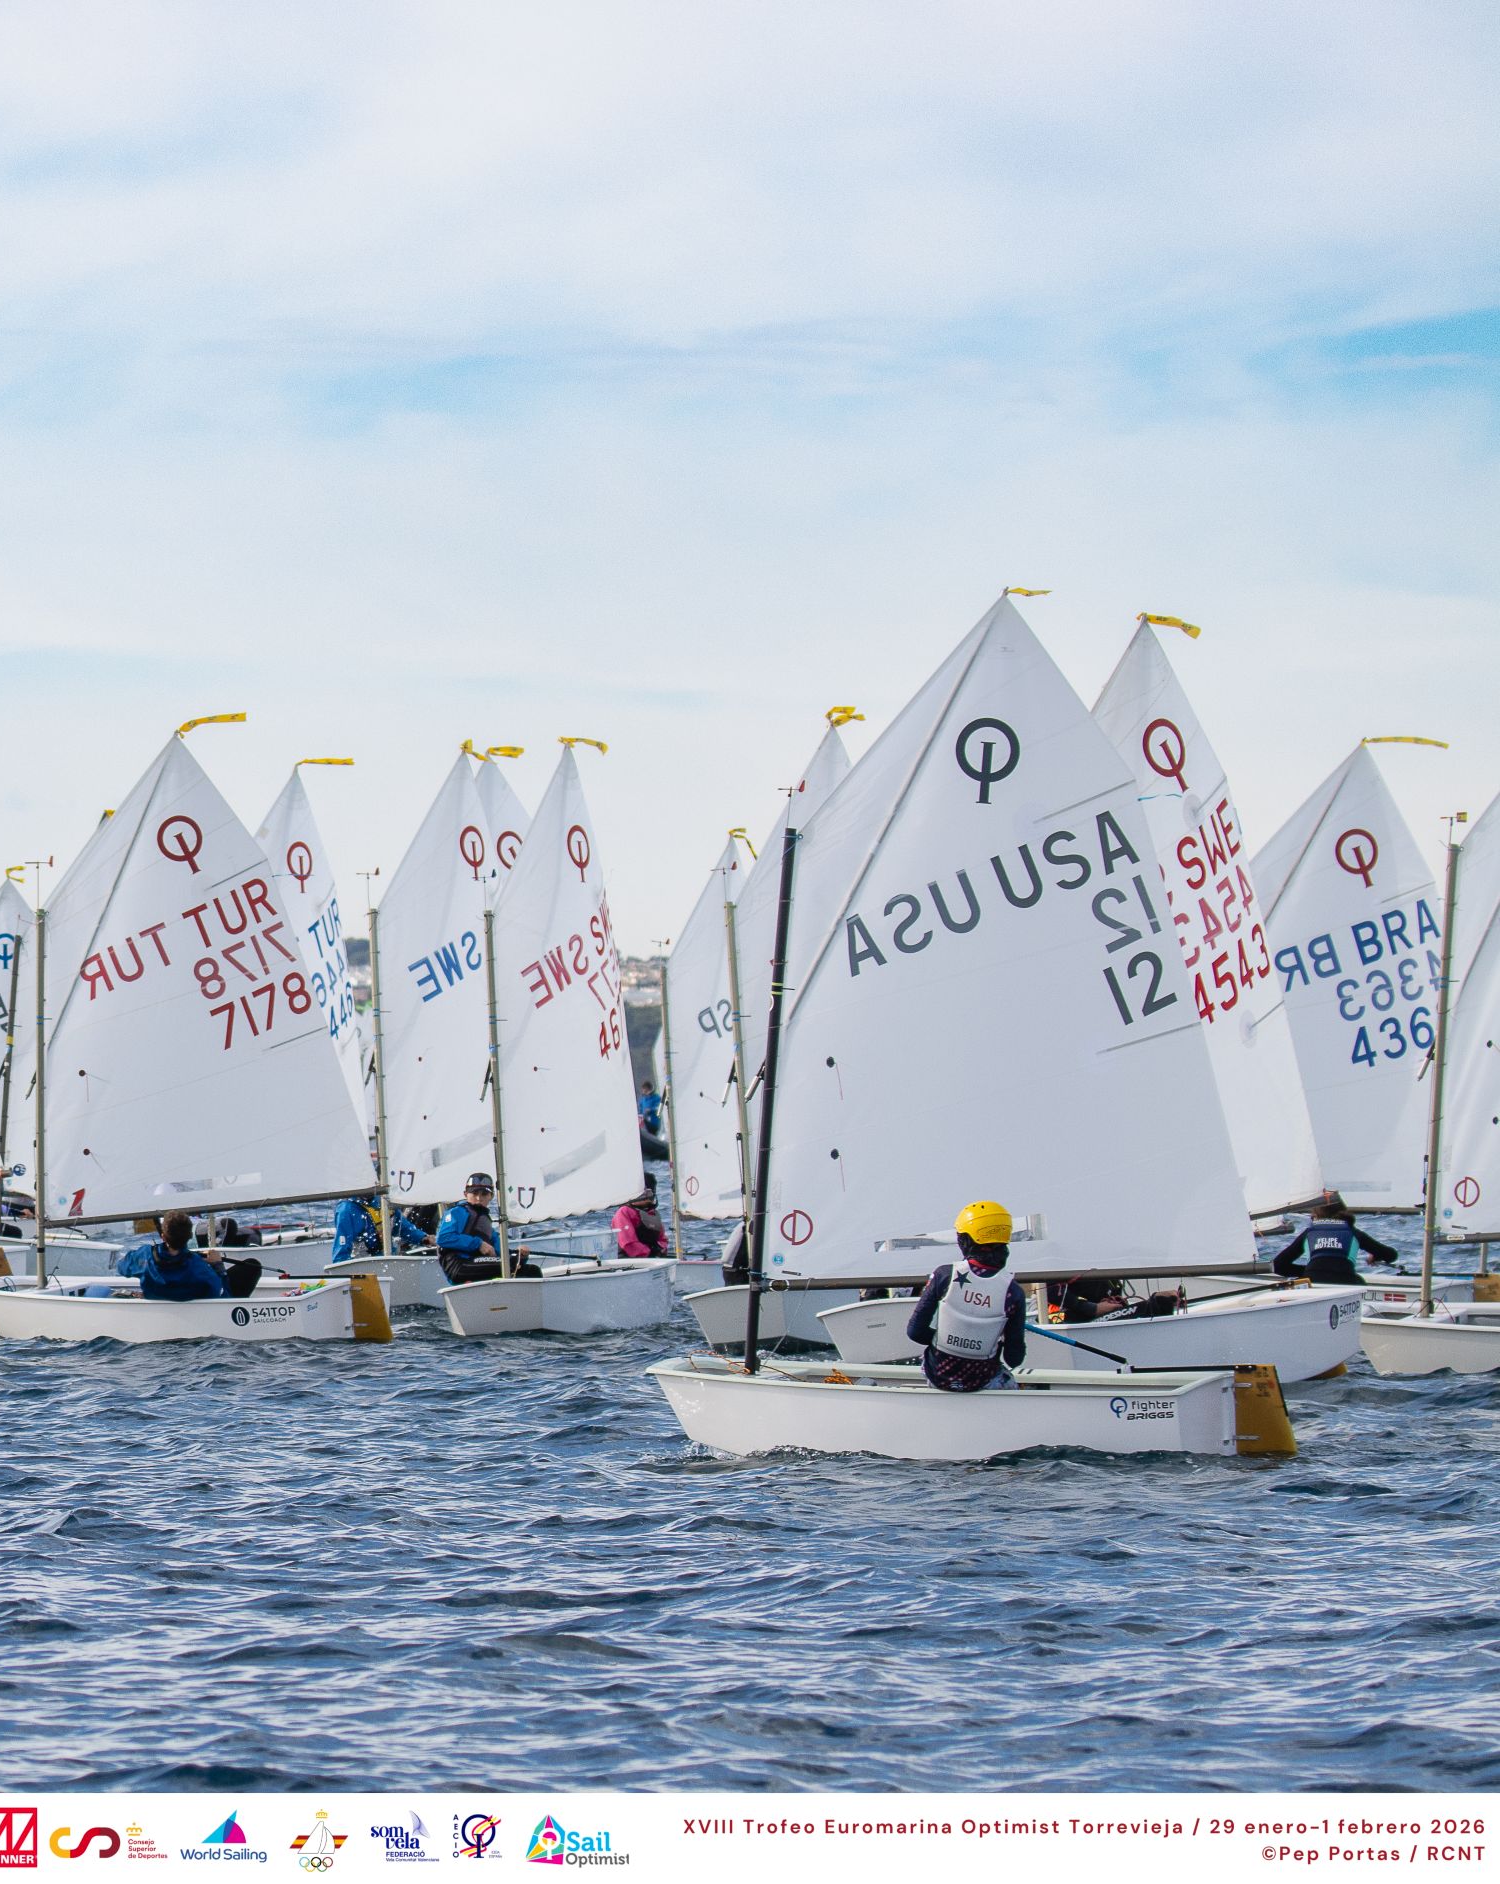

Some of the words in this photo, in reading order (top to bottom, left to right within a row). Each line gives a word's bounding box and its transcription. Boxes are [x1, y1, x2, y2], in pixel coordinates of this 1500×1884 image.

[990, 810, 1140, 909] USA
[1177, 797, 1241, 890] SWE
[181, 878, 278, 948] TUR
[307, 898, 342, 959] TUR
[1351, 898, 1442, 966] BRA
[1102, 951, 1178, 1026] 12
[1195, 923, 1271, 1024] 4543
[209, 971, 312, 1051] 7178
[328, 980, 354, 1041] 446
[1351, 1006, 1435, 1067] 436
[252, 1306, 296, 1318] 541TOP
[964, 1290, 991, 1308] USA
[946, 1334, 982, 1351] BRIGGS
[1127, 1411, 1174, 1421] BRIGGS
[1131, 1400, 1175, 1412] fighter
